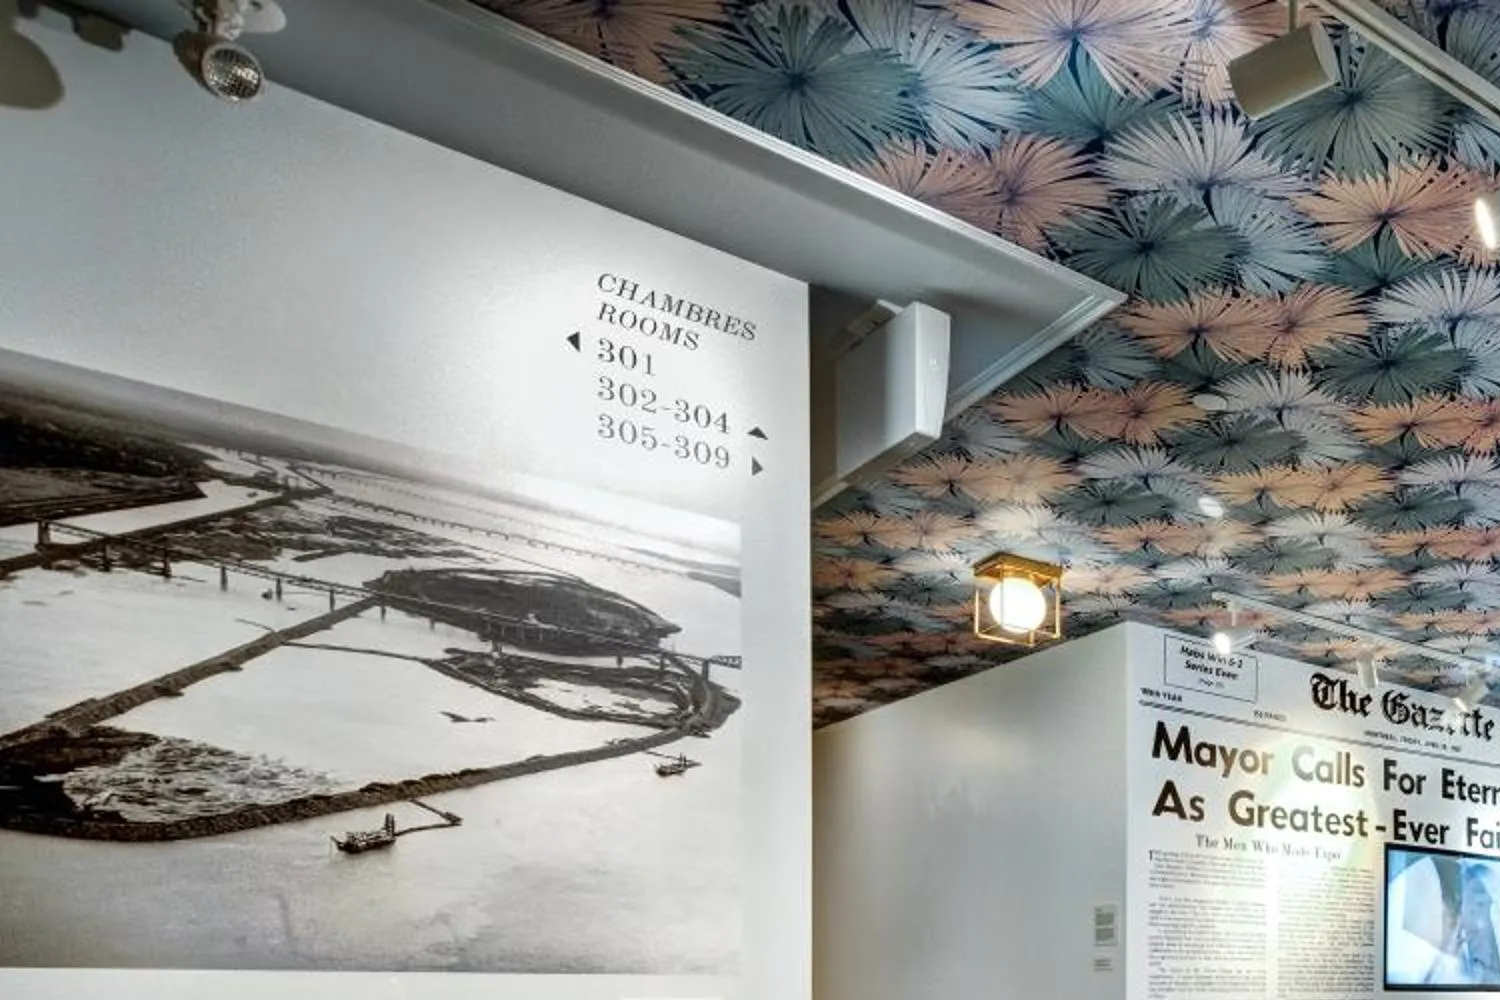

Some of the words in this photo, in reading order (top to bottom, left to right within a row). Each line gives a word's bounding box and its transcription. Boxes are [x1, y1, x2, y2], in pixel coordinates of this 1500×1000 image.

[596, 273, 758, 342] CHAMBRES
[596, 302, 701, 352] ROOMS
[597, 337, 656, 377] 301
[597, 375, 730, 435] 302-304
[597, 412, 731, 470] 305-309
[1310, 672, 1373, 718] The
[1151, 720, 1275, 779] Mayor
[1292, 745, 1366, 788] Calls
[1383, 758, 1427, 796] For
[1151, 779, 1206, 823] As
[1195, 833, 1218, 849] The
[1223, 837, 1247, 850] Men
